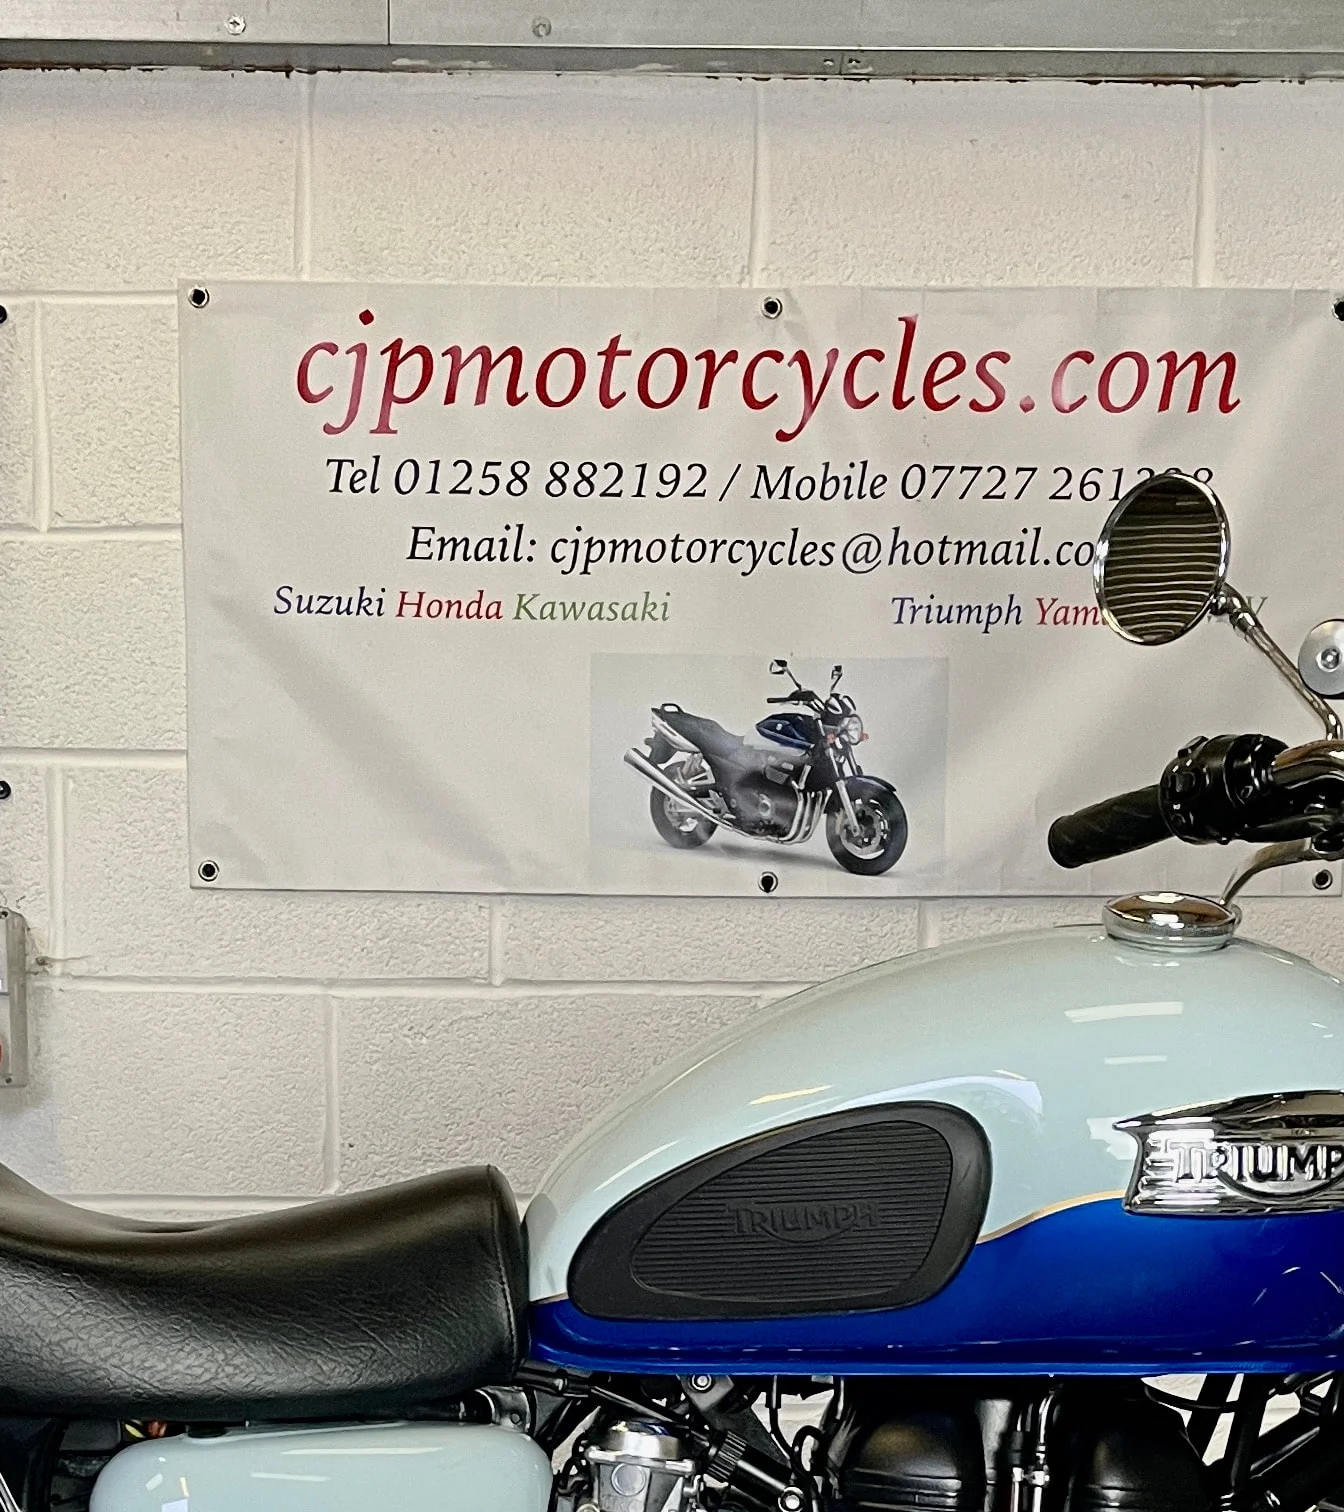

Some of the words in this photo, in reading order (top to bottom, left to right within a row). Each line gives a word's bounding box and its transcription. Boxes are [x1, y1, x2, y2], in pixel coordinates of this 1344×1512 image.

[297, 309, 1241, 442] cjpmotorcycles.com
[325, 455, 381, 494] Tel
[394, 458, 531, 497] 01258
[544, 460, 708, 499] 882192
[718, 463, 742, 502] /
[749, 459, 888, 501] Mobile
[900, 463, 1038, 502] 07727
[1048, 467, 1214, 502] 261
[405, 523, 537, 563] Email:
[550, 524, 1095, 577] cjpmotorcycles@hotmail.co
[272, 585, 386, 617] Suzuki
[395, 590, 504, 621] Honda
[512, 591, 671, 622] Kawasaki
[890, 594, 1023, 635] Triumph
[1034, 597, 1109, 627] Yam
[726, 1200, 880, 1243] TRIUMPH
